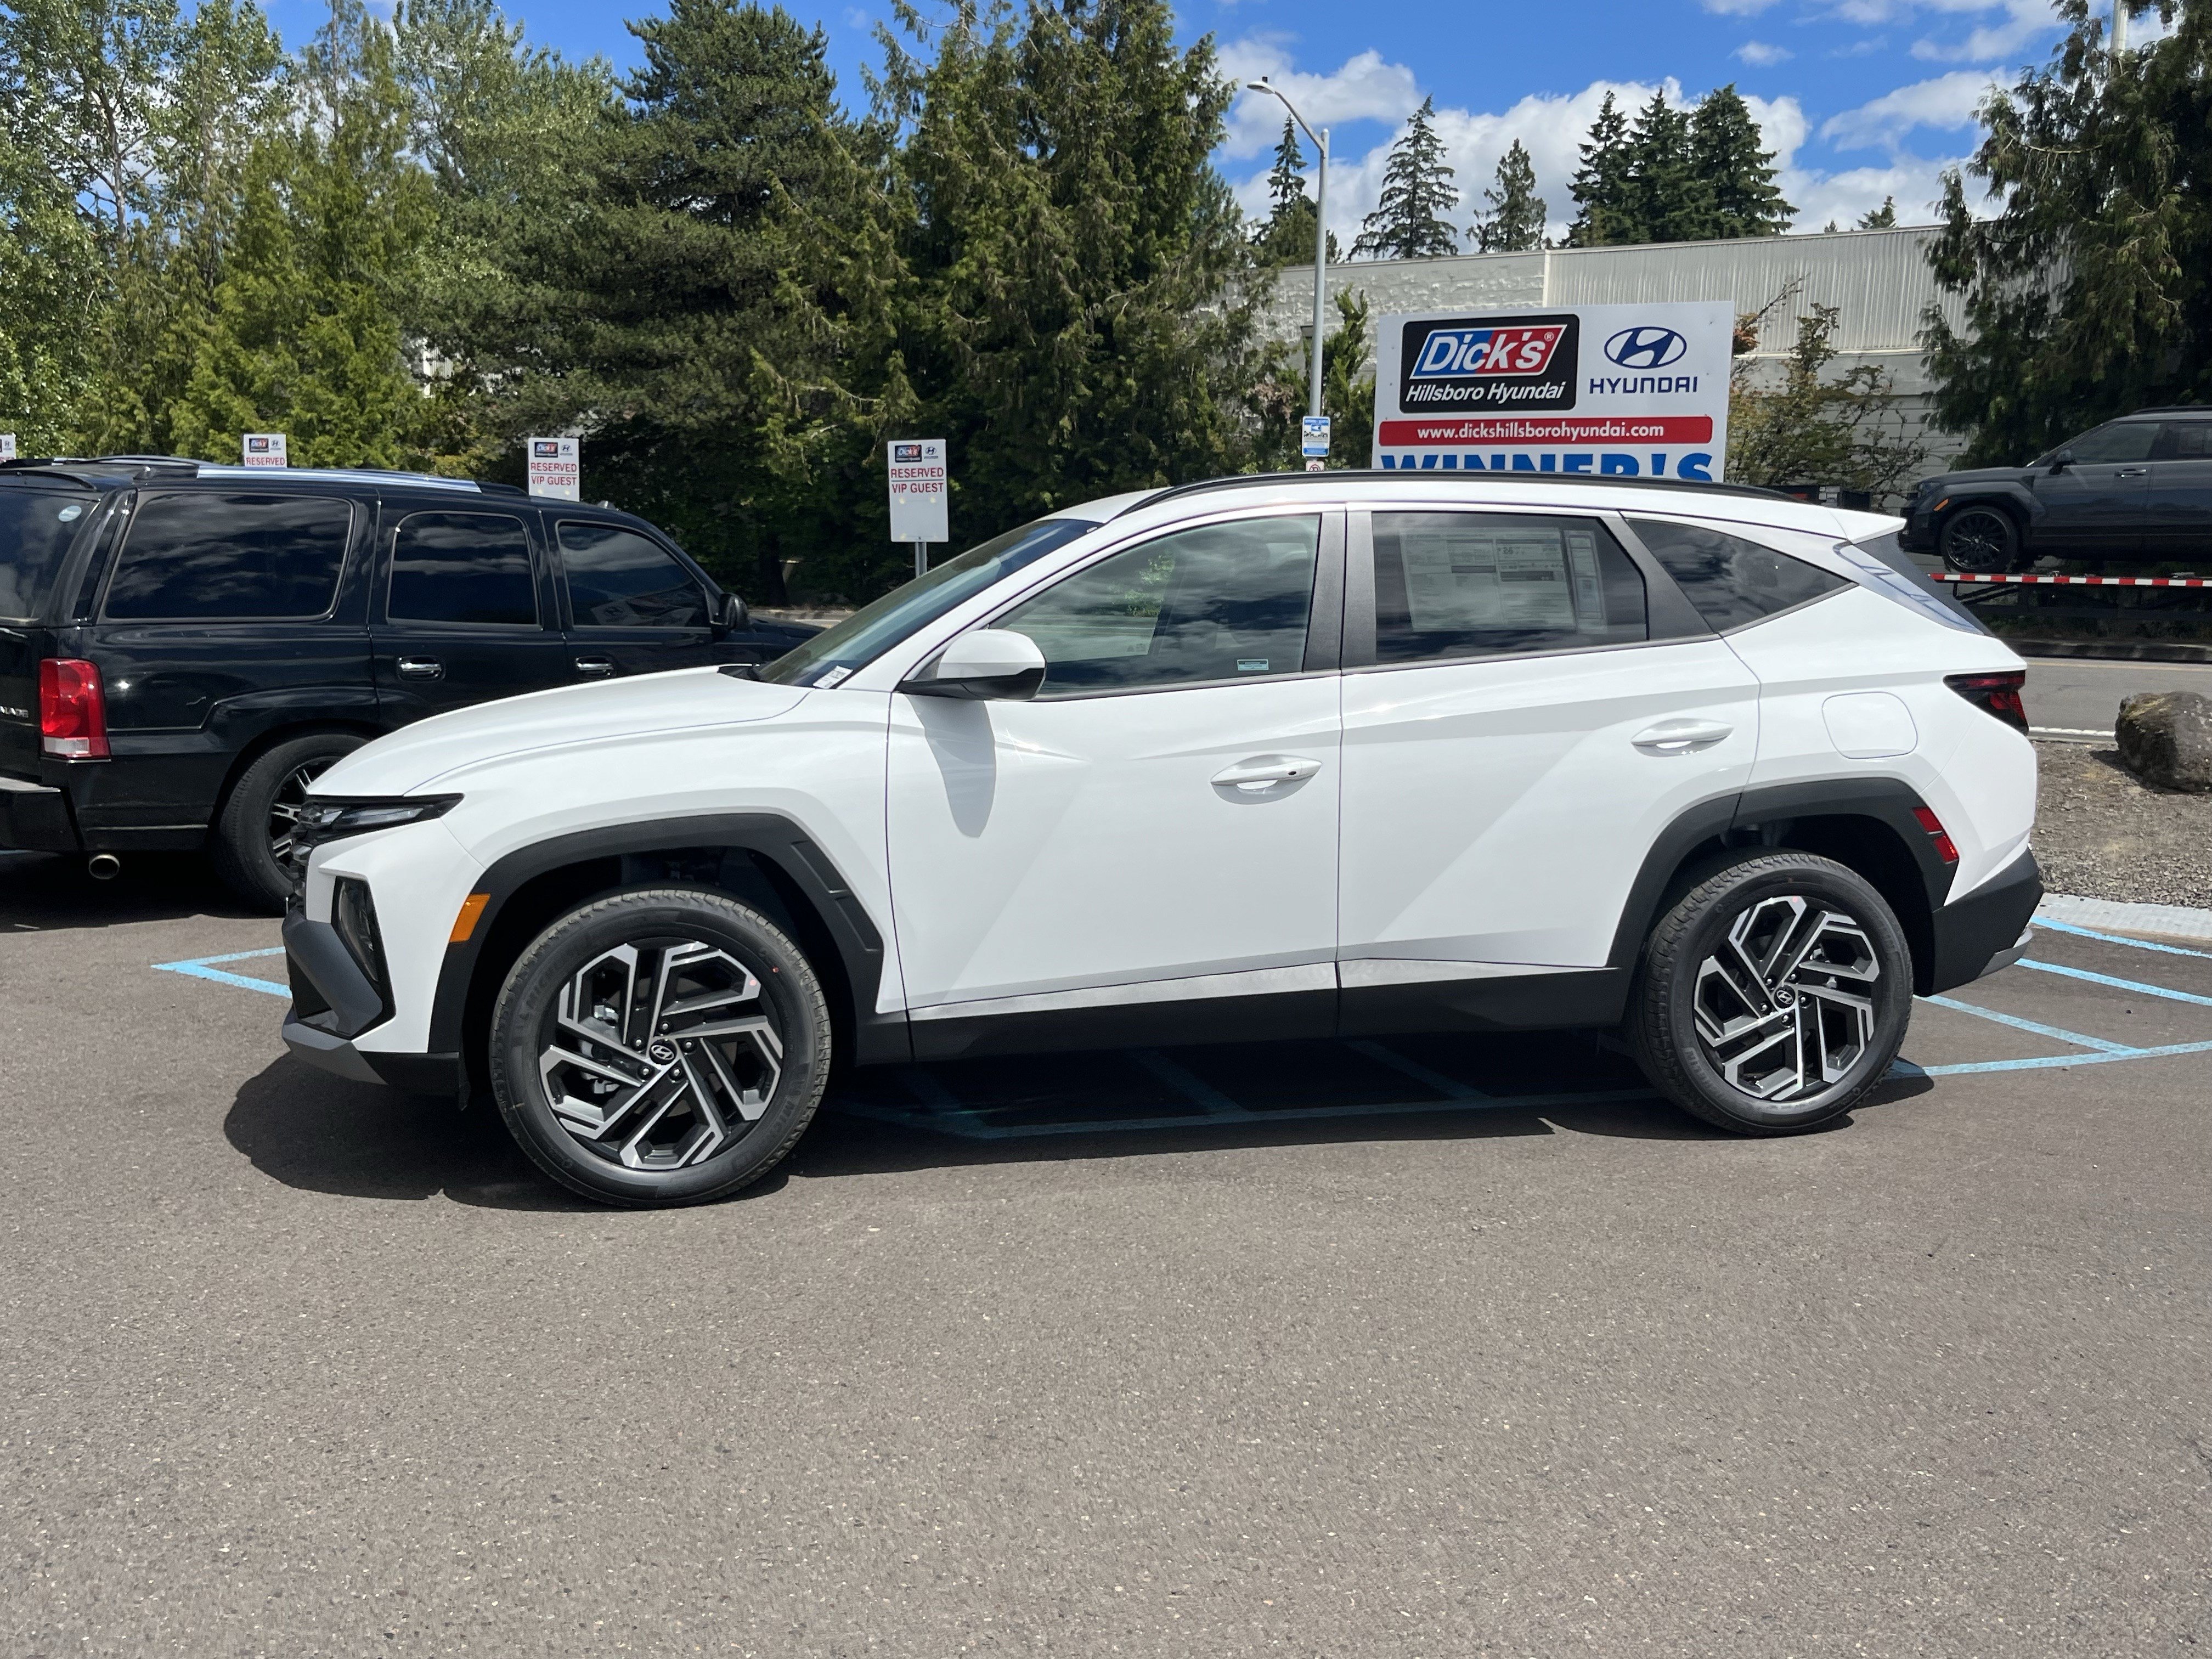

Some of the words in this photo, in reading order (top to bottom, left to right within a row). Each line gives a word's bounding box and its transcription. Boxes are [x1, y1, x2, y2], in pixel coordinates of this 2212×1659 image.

[1589, 376, 1698, 394] HYUNDAI
[1406, 383, 1485, 402] Hillsboro
[1487, 381, 1567, 404] Hyundai
[1417, 421, 1664, 441] www.dickshillsborohyundai.com
[246, 456, 285, 465] RESERVED
[531, 462, 577, 472] RESERVED
[890, 467, 944, 478] RESERVED
[531, 476, 545, 484] VIP
[548, 477, 577, 486] GUEST
[892, 483, 907, 493] VIP
[910, 483, 944, 493] GUEST
